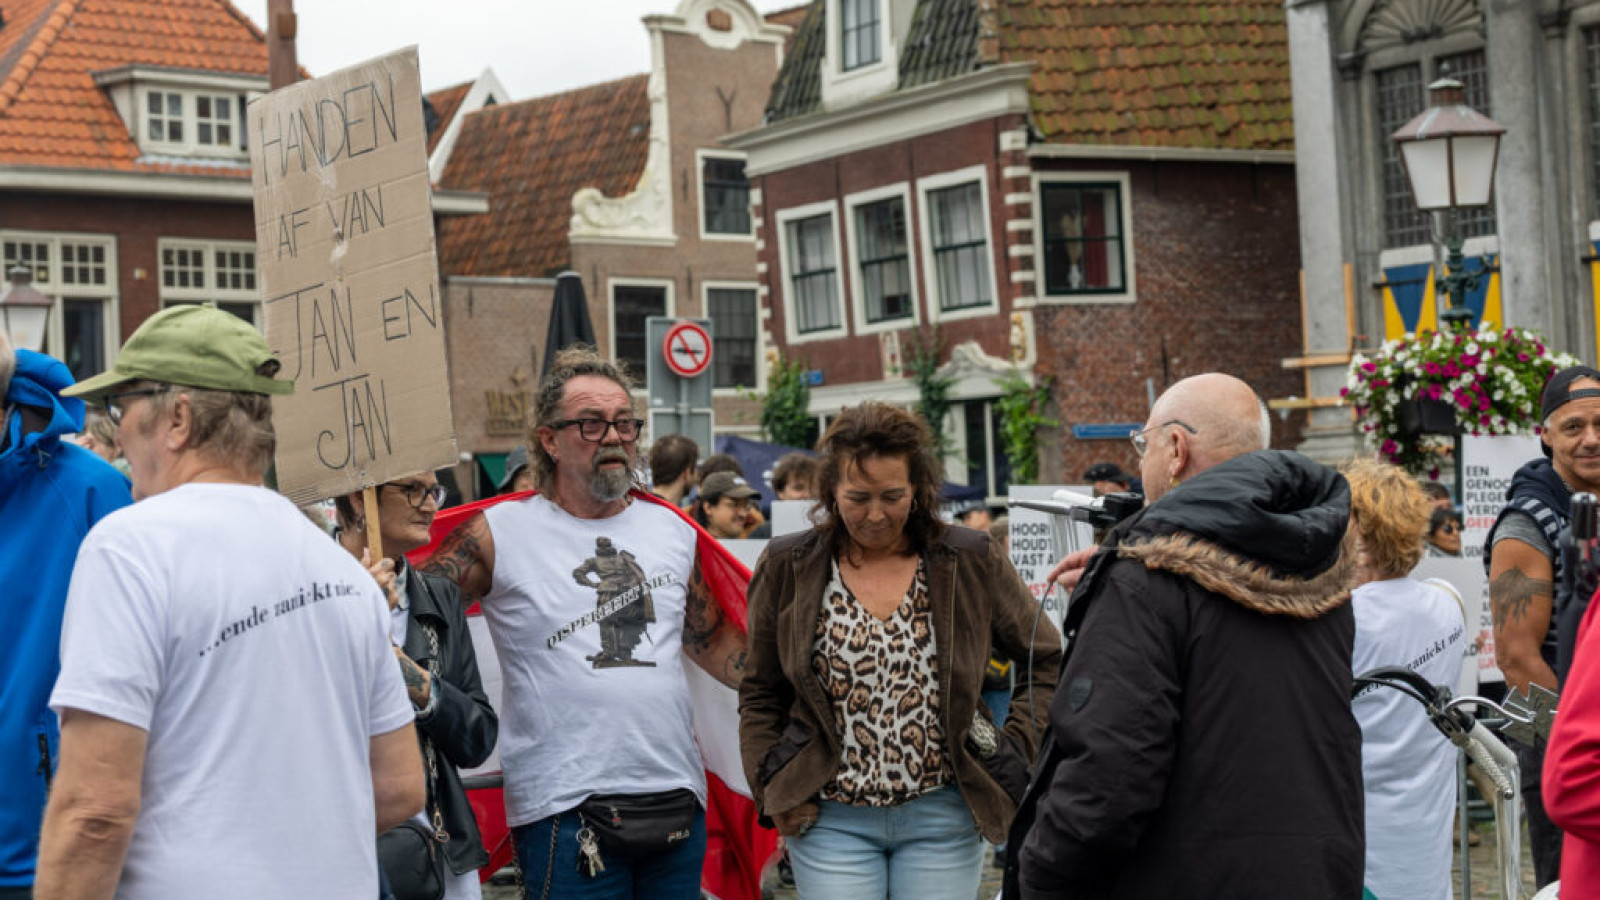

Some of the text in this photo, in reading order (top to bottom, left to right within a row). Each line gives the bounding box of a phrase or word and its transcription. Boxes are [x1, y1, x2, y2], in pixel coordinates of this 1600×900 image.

[260, 73, 398, 187] HANDEN
[277, 184, 385, 261] AF VAN
[264, 282, 437, 381] JAN EN
[312, 373, 392, 470] JAN
[1466, 466, 1489, 476] EEN
[1466, 480, 1511, 489] GENOC
[1466, 492, 1505, 502] PLEGE
[1466, 505, 1500, 514] VERD
[1012, 523, 1051, 536] HOOR
[1012, 554, 1043, 565] VAST
